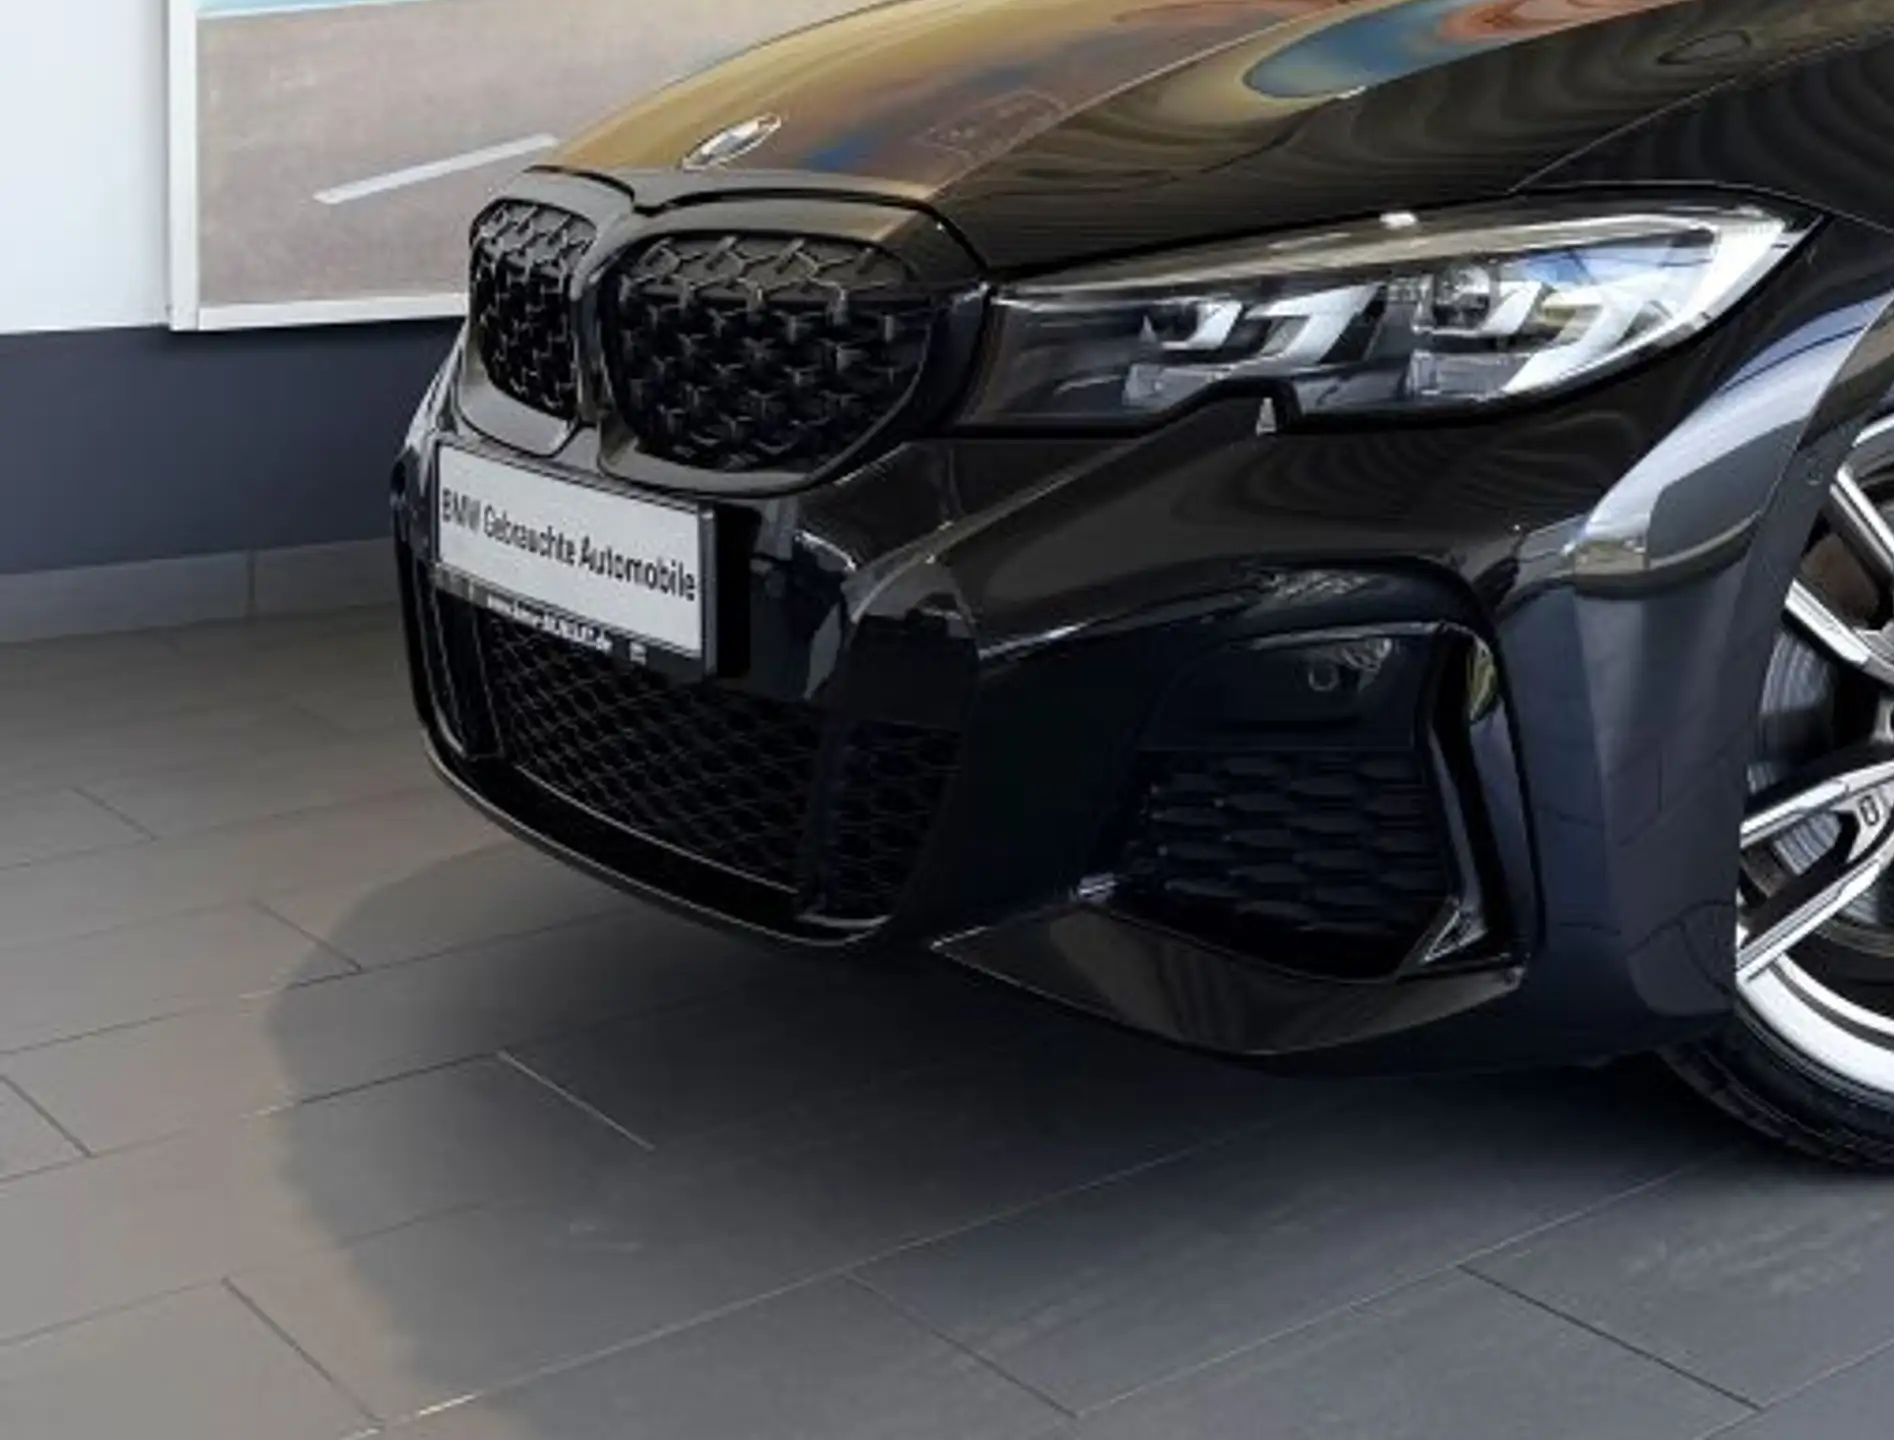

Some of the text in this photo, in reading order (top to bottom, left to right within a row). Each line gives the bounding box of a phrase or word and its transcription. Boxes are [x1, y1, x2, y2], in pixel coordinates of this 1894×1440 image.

[442, 486, 696, 601] BMW Gebrauchte Automobile
